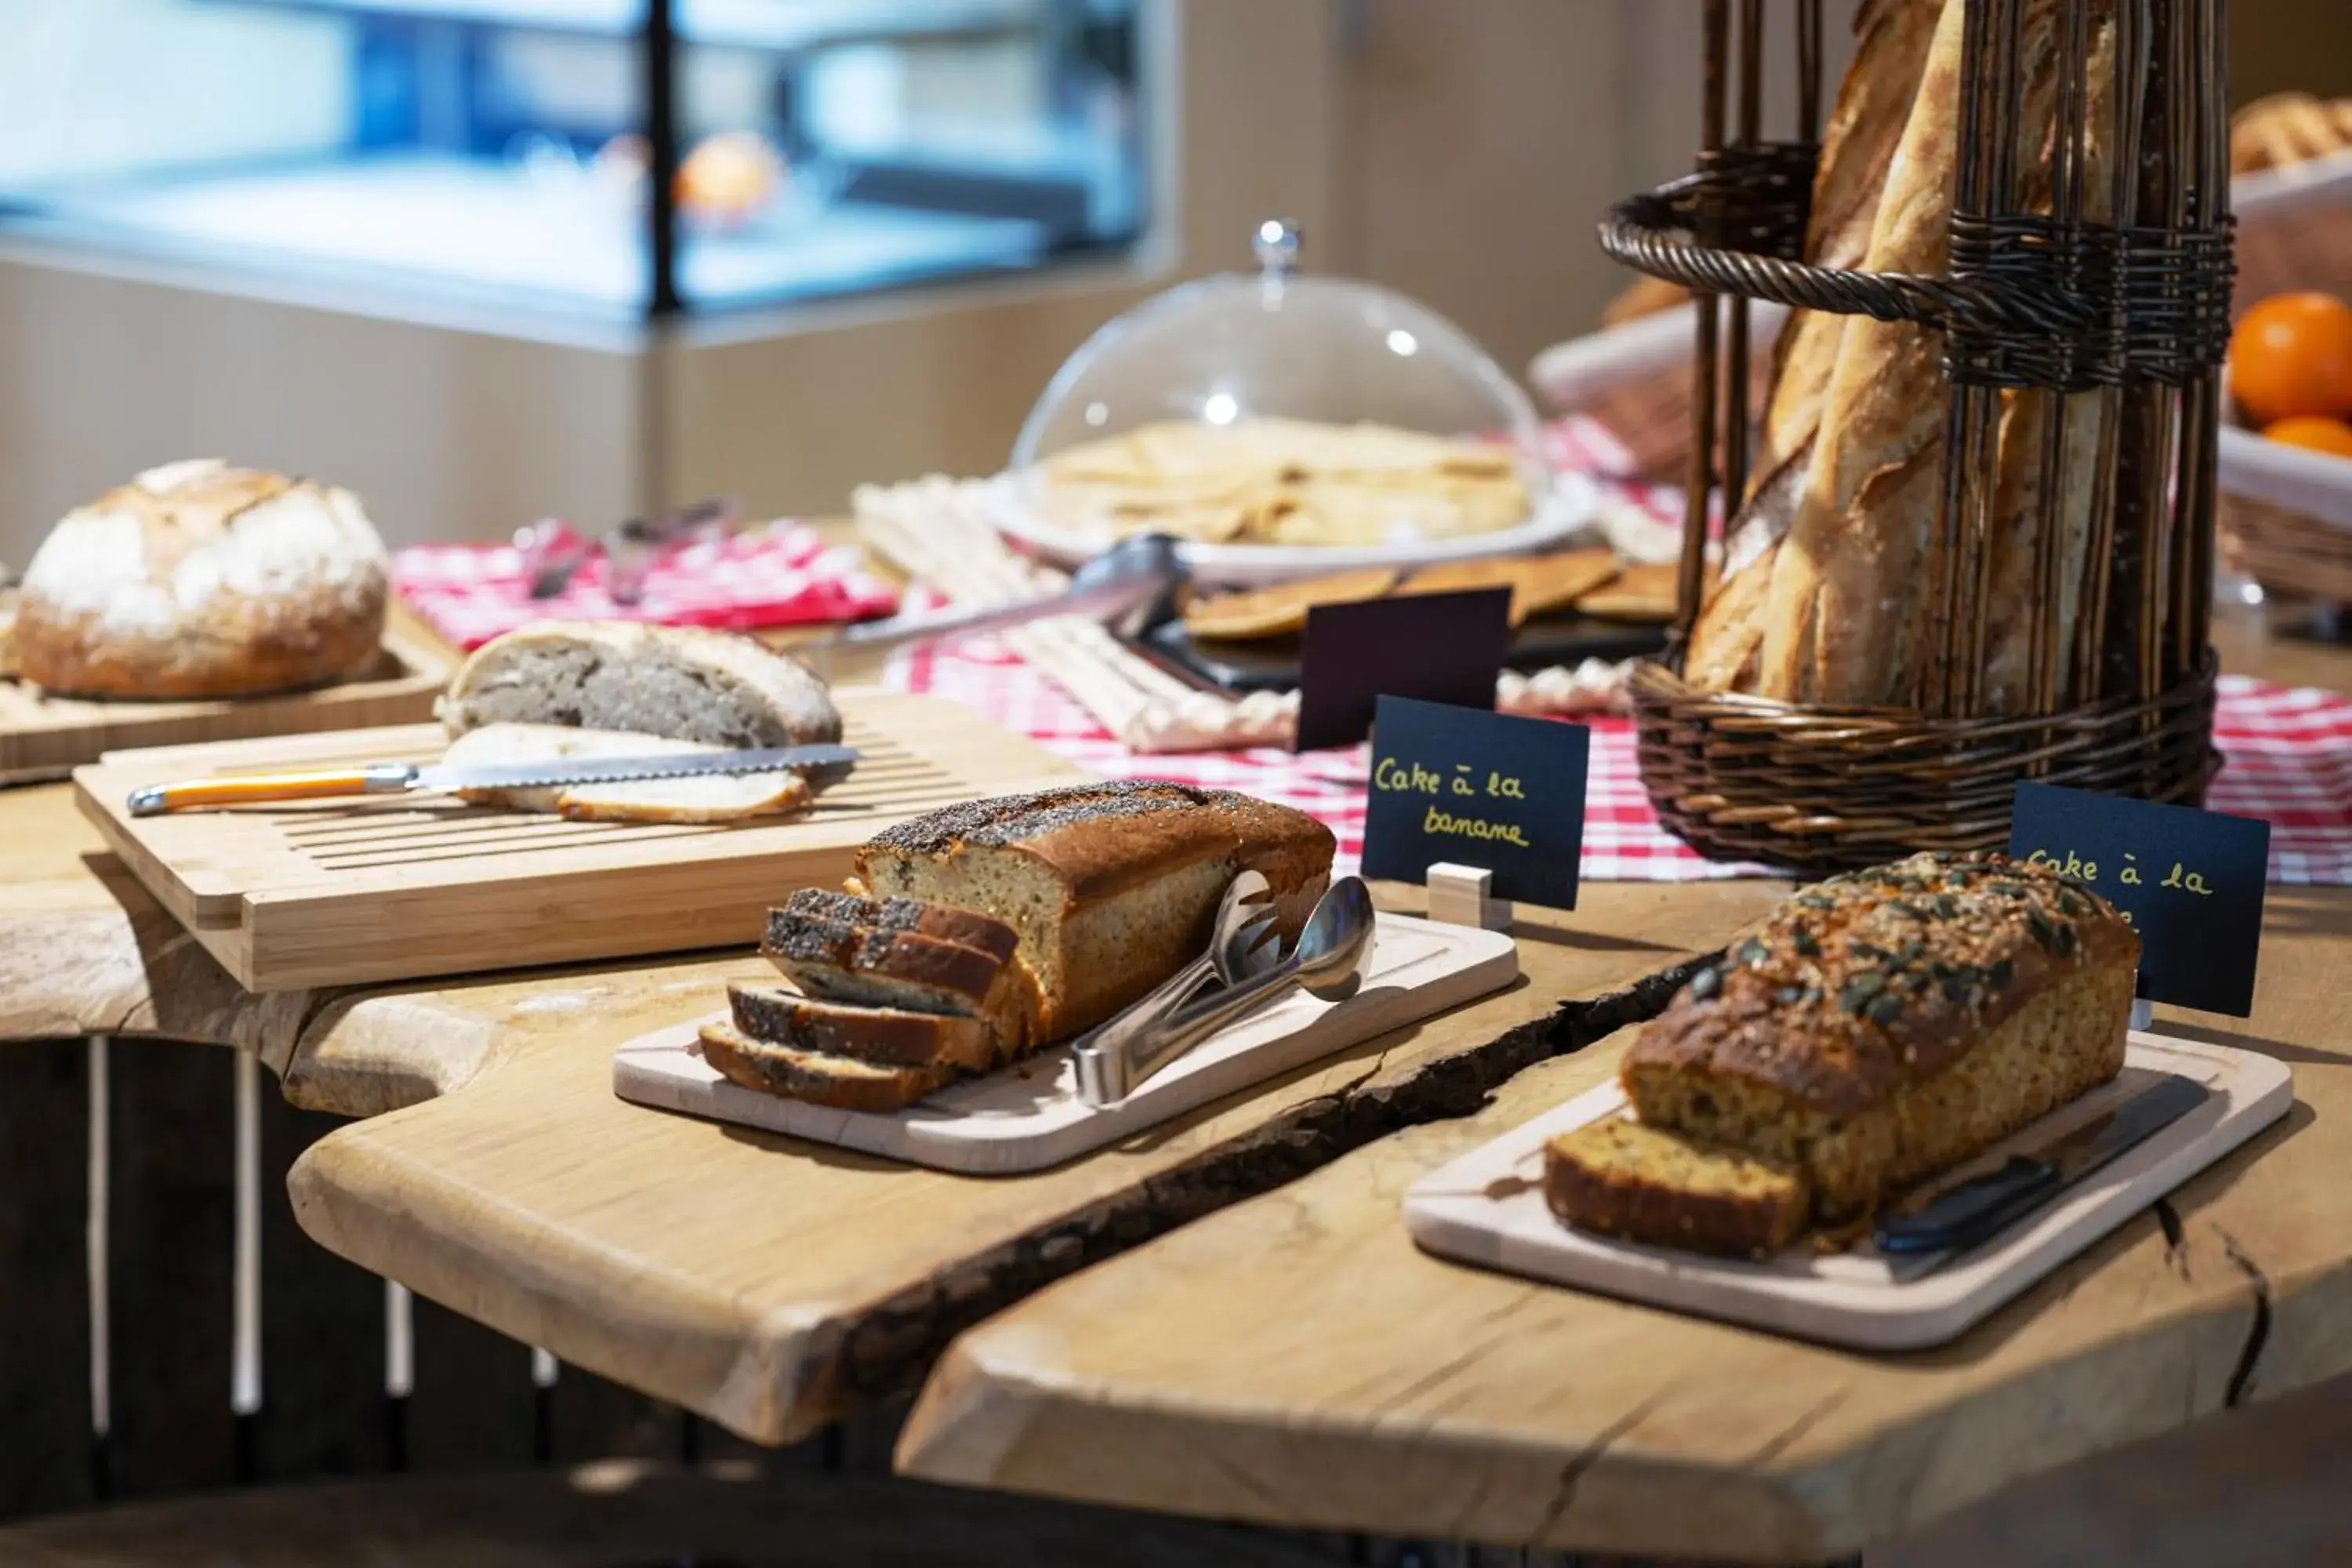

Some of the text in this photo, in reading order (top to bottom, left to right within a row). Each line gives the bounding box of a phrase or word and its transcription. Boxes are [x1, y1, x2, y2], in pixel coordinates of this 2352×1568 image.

[1375, 757, 1441, 794] Cake
[1486, 771, 1526, 799] la
[1425, 804, 1530, 848] banane
[2119, 852, 2143, 885] à
[2160, 862, 2213, 895] la
